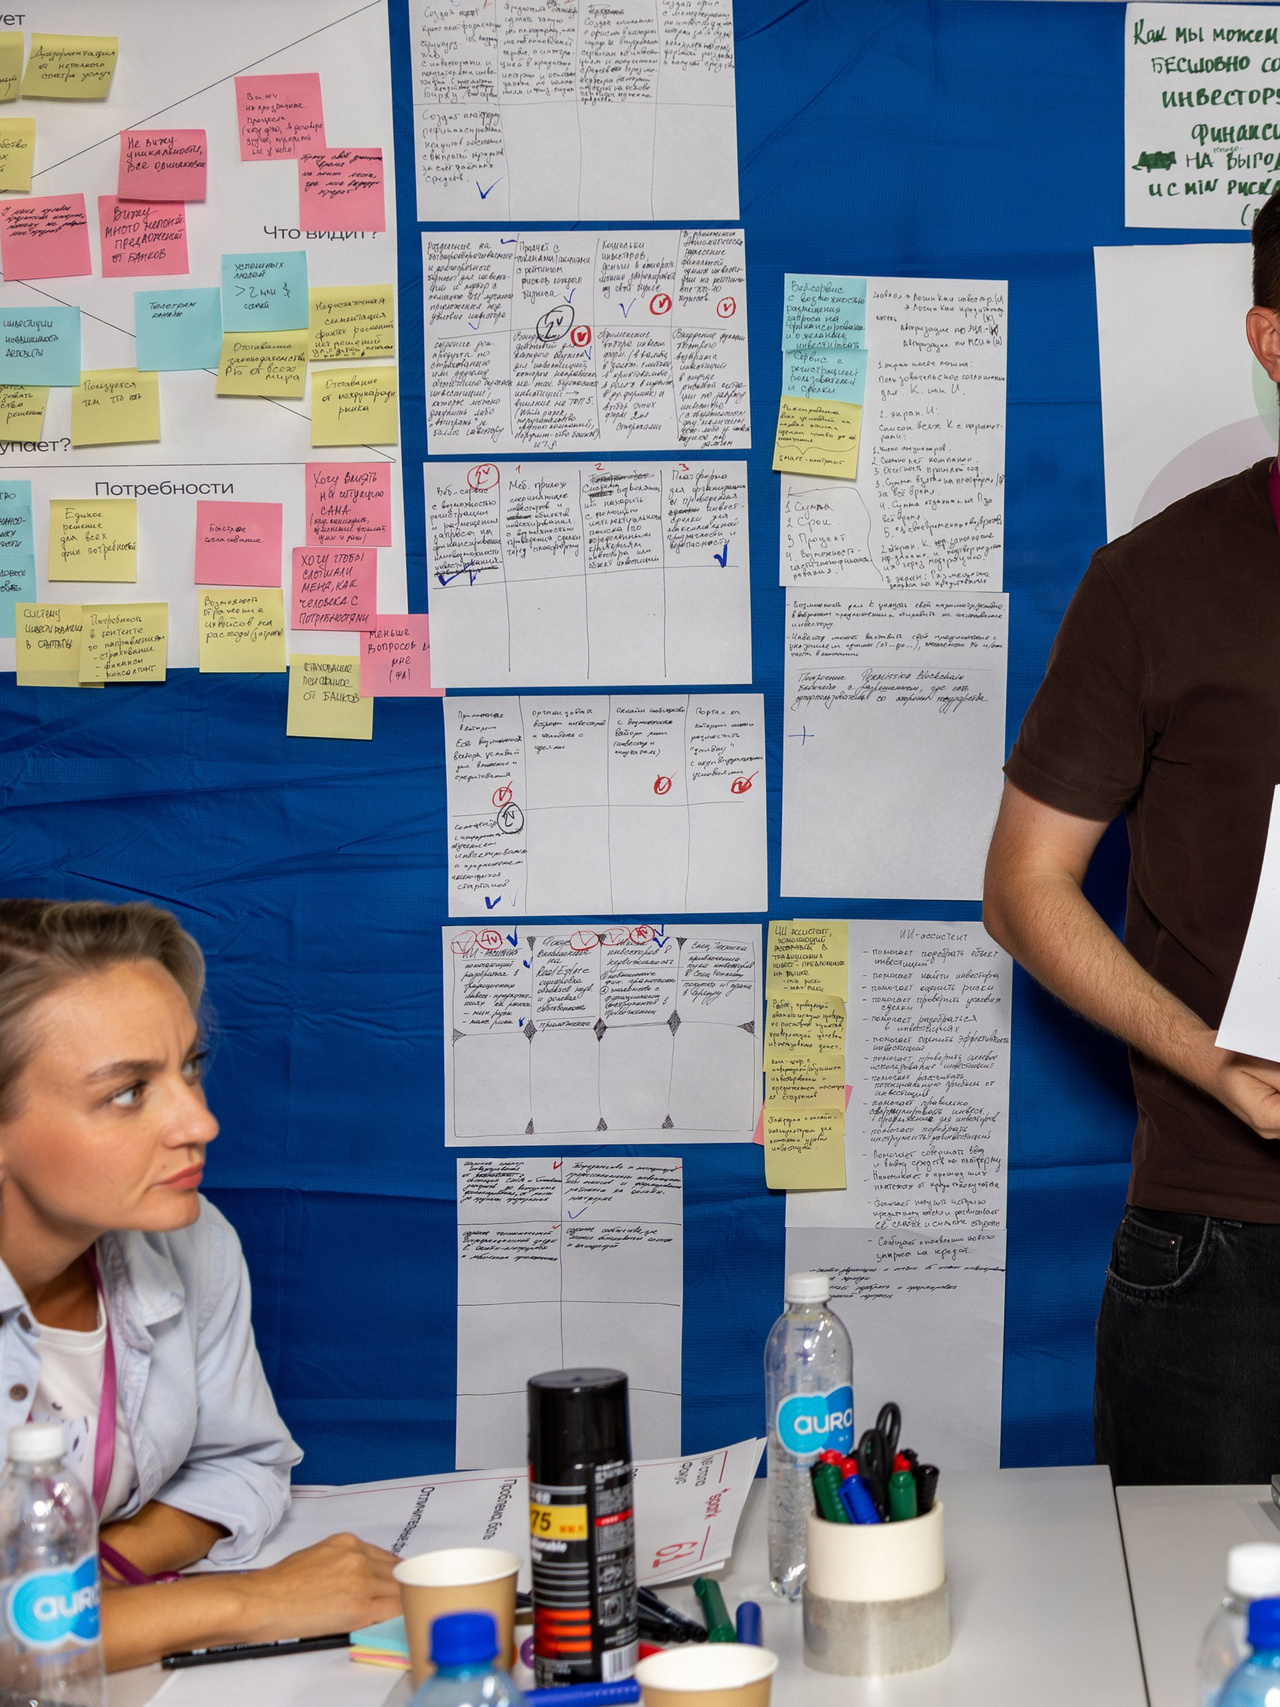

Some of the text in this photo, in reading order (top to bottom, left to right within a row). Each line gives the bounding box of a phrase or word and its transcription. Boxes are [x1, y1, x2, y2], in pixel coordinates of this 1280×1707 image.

[1133, 19, 1167, 45] Как
[1175, 26, 1204, 44] мы
[1213, 26, 1279, 45] можем
[128, 136, 143, 149] Не
[264, 226, 301, 240] Что
[94, 480, 235, 499] Потребности
